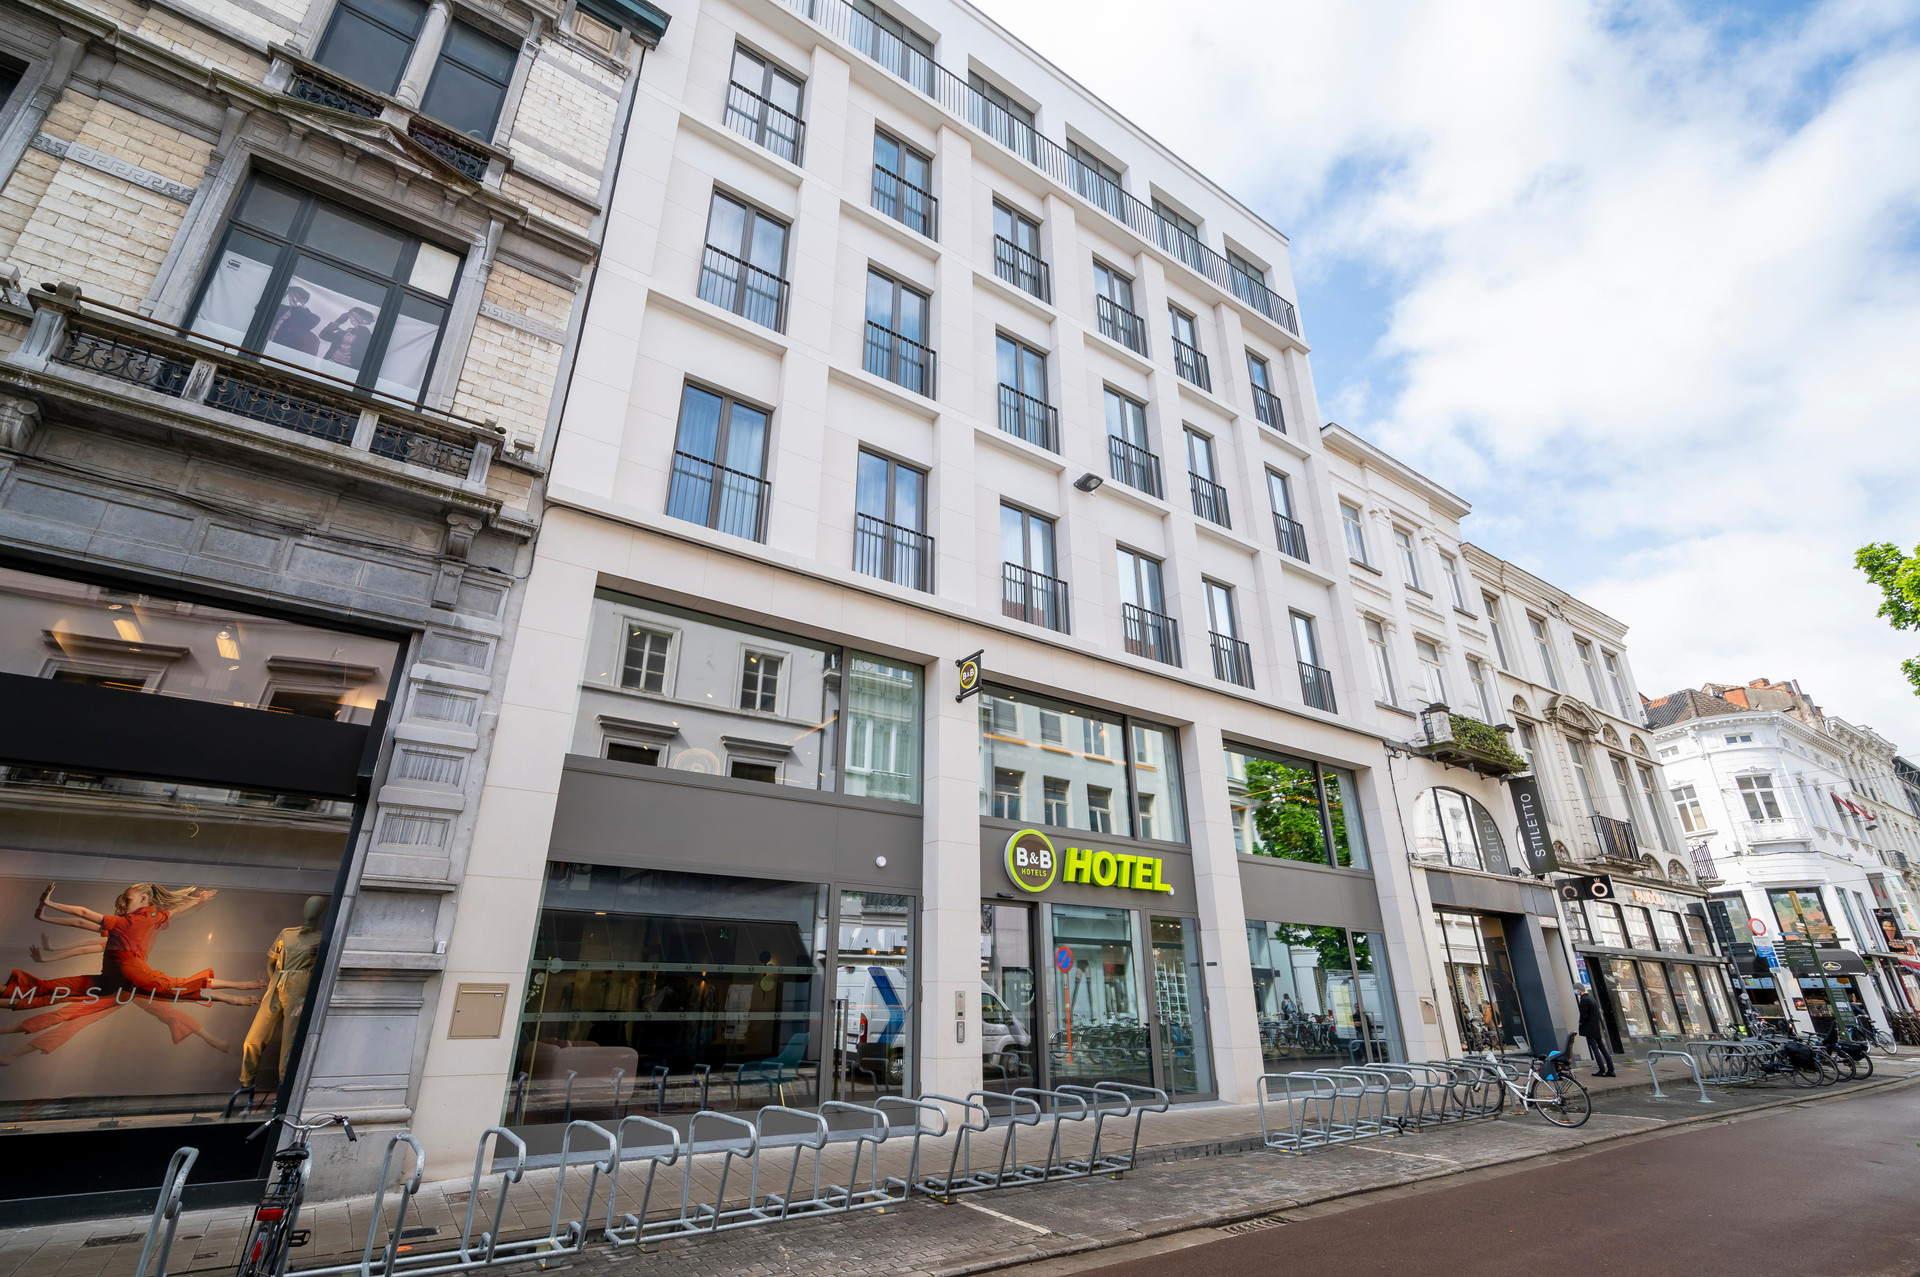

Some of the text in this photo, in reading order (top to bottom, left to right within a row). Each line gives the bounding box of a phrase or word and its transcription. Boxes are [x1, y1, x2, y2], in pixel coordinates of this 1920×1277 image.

[1520, 793, 1547, 857] STILETTO
[1016, 847, 1052, 869] B&B
[1021, 868, 1047, 877] HOTELS
[1063, 848, 1171, 892] HOTEL
